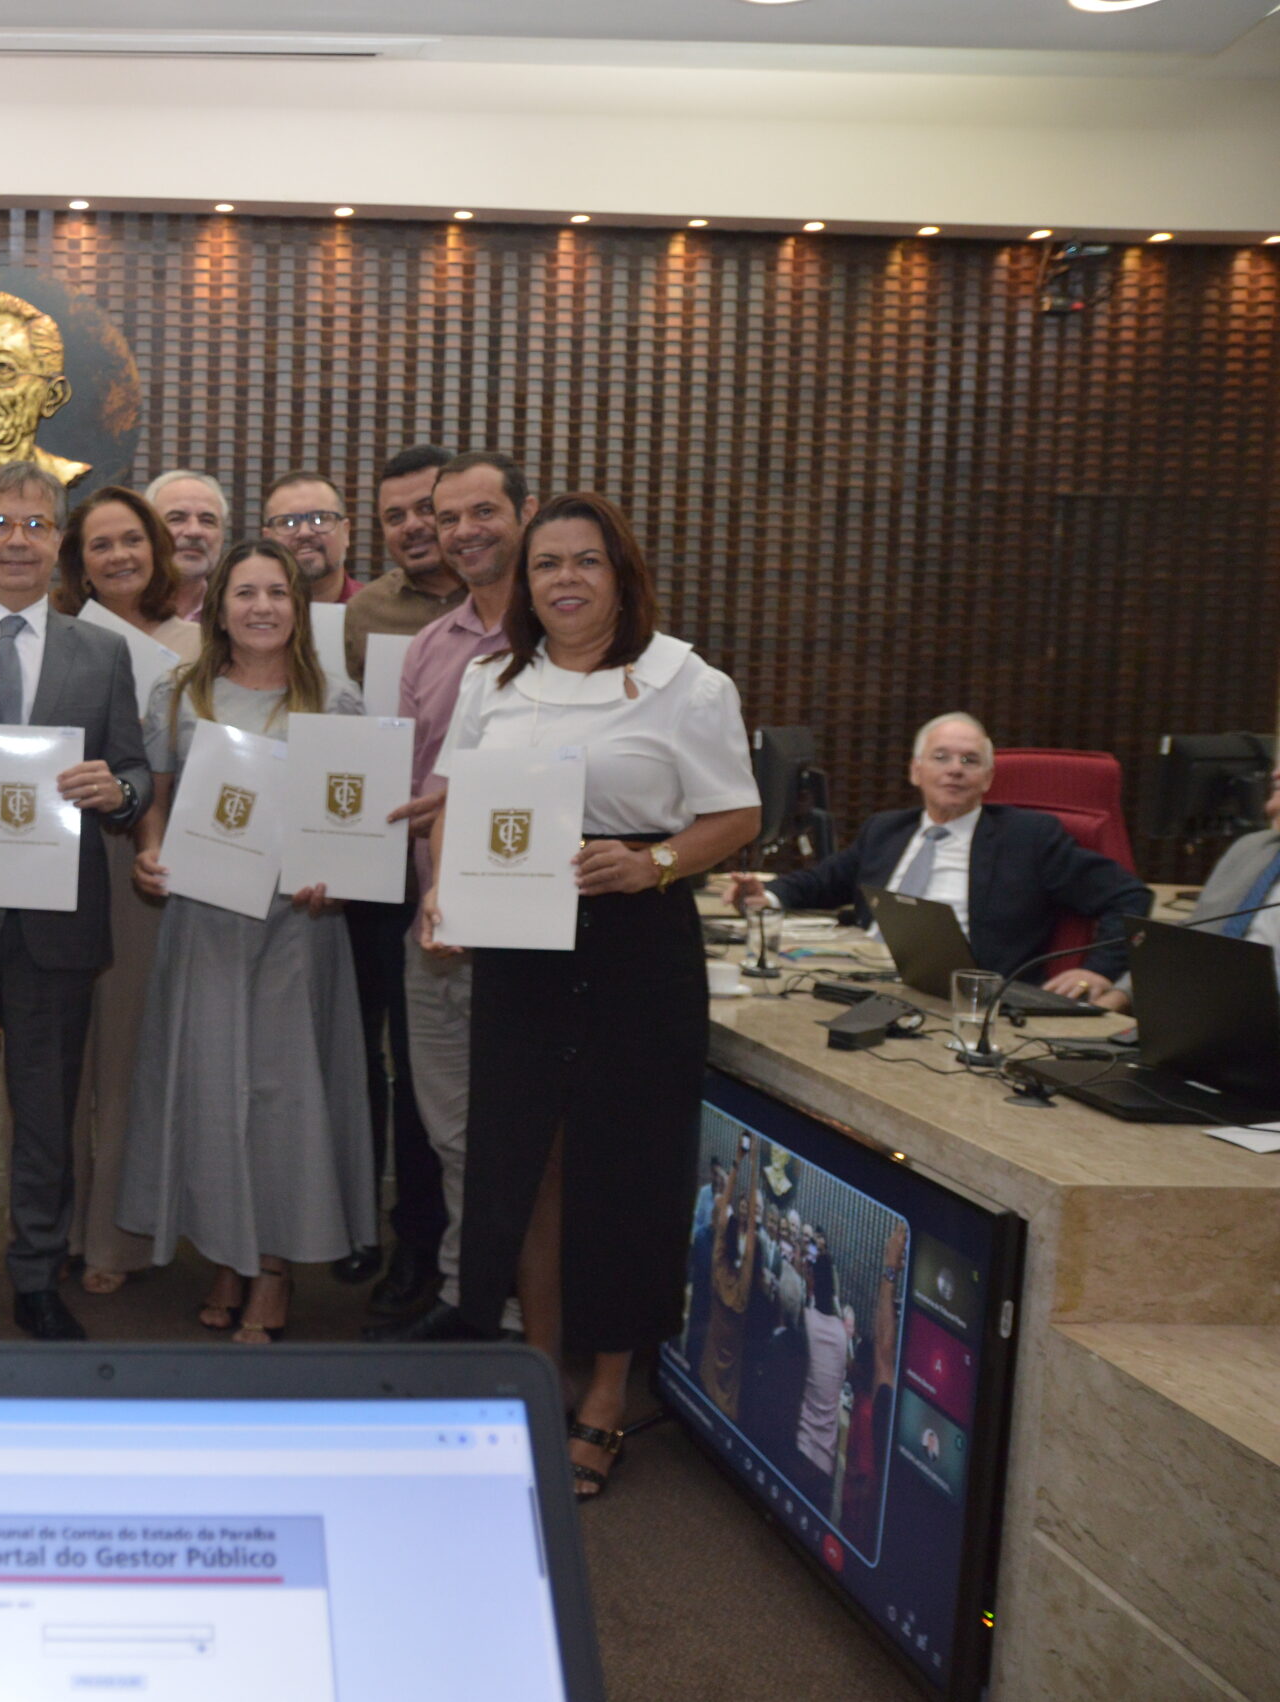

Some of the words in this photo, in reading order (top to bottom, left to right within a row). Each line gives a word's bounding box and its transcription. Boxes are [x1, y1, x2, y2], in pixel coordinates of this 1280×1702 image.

[39, 1526, 57, 1540] de
[62, 1527, 113, 1541] Contas
[118, 1526, 137, 1541] do
[142, 1527, 193, 1541] Estado
[198, 1527, 216, 1541] da
[54, 1545, 87, 1569] do
[95, 1546, 177, 1569] Gestor
[186, 1545, 277, 1569] Público
